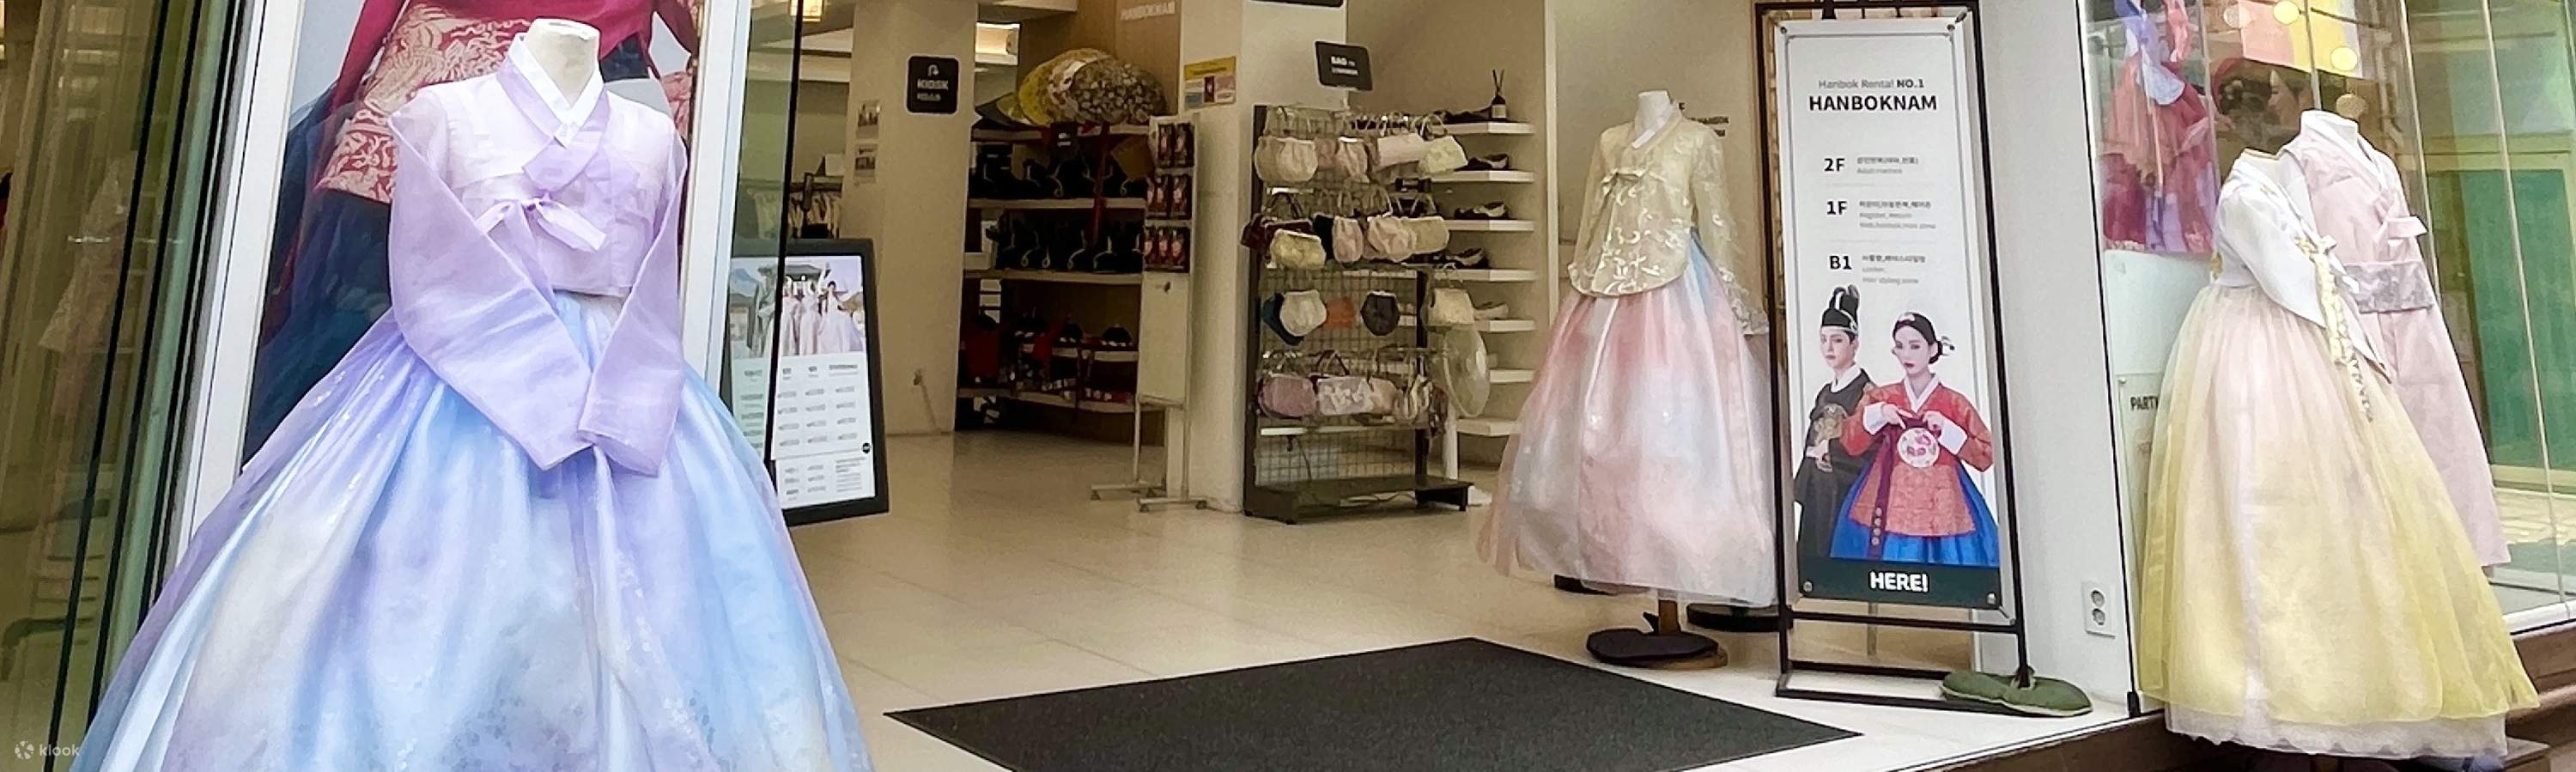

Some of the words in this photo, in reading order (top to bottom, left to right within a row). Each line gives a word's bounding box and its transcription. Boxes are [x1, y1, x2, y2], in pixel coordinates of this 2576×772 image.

[1862, 79, 1893, 88] Rental
[1897, 79, 1924, 88] NO.1
[1809, 95, 1937, 111] HANBOKNAM
[1824, 158, 1845, 172] 2F
[1827, 201, 1848, 215] 1F
[1829, 255, 1852, 270] B1
[1869, 571, 1929, 593] HERE!
